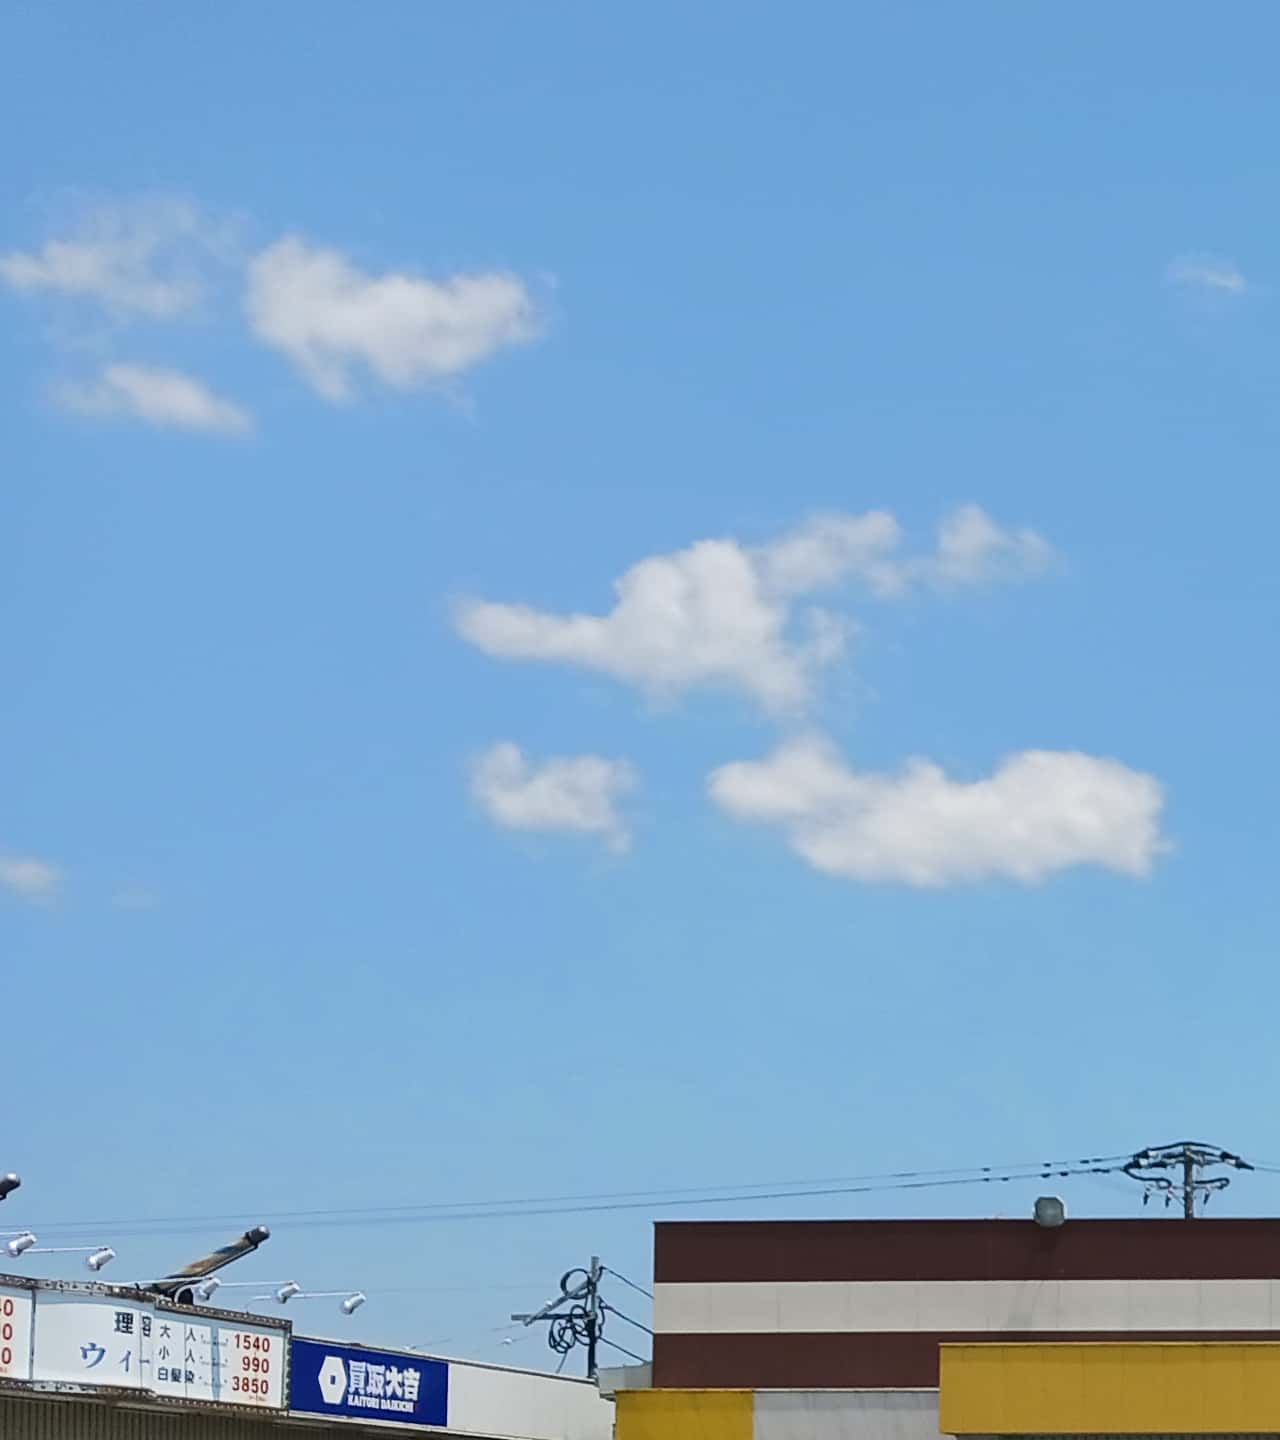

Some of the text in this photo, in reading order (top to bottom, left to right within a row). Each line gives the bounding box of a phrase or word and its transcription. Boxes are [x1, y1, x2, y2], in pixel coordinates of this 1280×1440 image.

[234, 1333, 270, 1353] 1540
[242, 1356, 269, 1373] 990
[232, 1376, 269, 1394] 3850
[349, 1360, 421, 1400] 買取大吉
